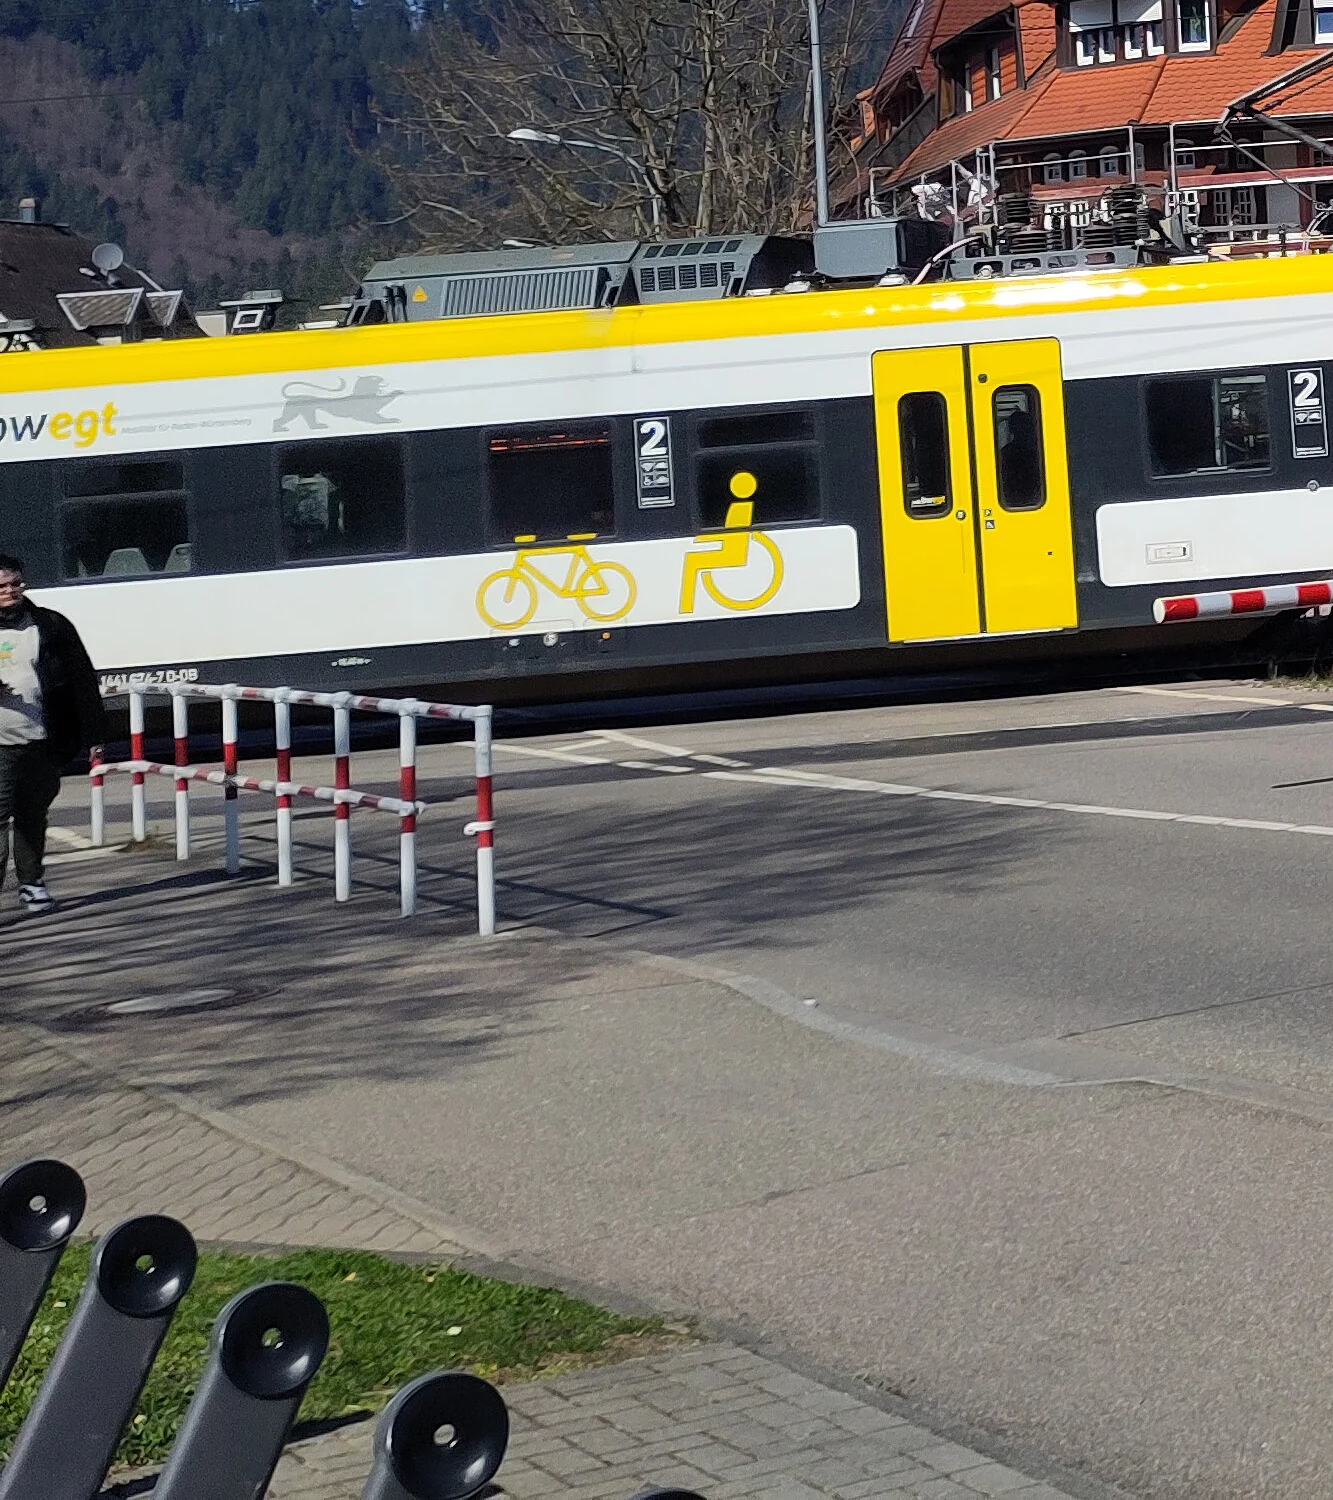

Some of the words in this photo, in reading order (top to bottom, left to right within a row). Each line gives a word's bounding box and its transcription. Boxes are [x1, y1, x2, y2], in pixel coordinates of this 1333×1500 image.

[1293, 371, 1321, 407] 2
[0, 401, 119, 449] wegt
[639, 420, 668, 457] 2
